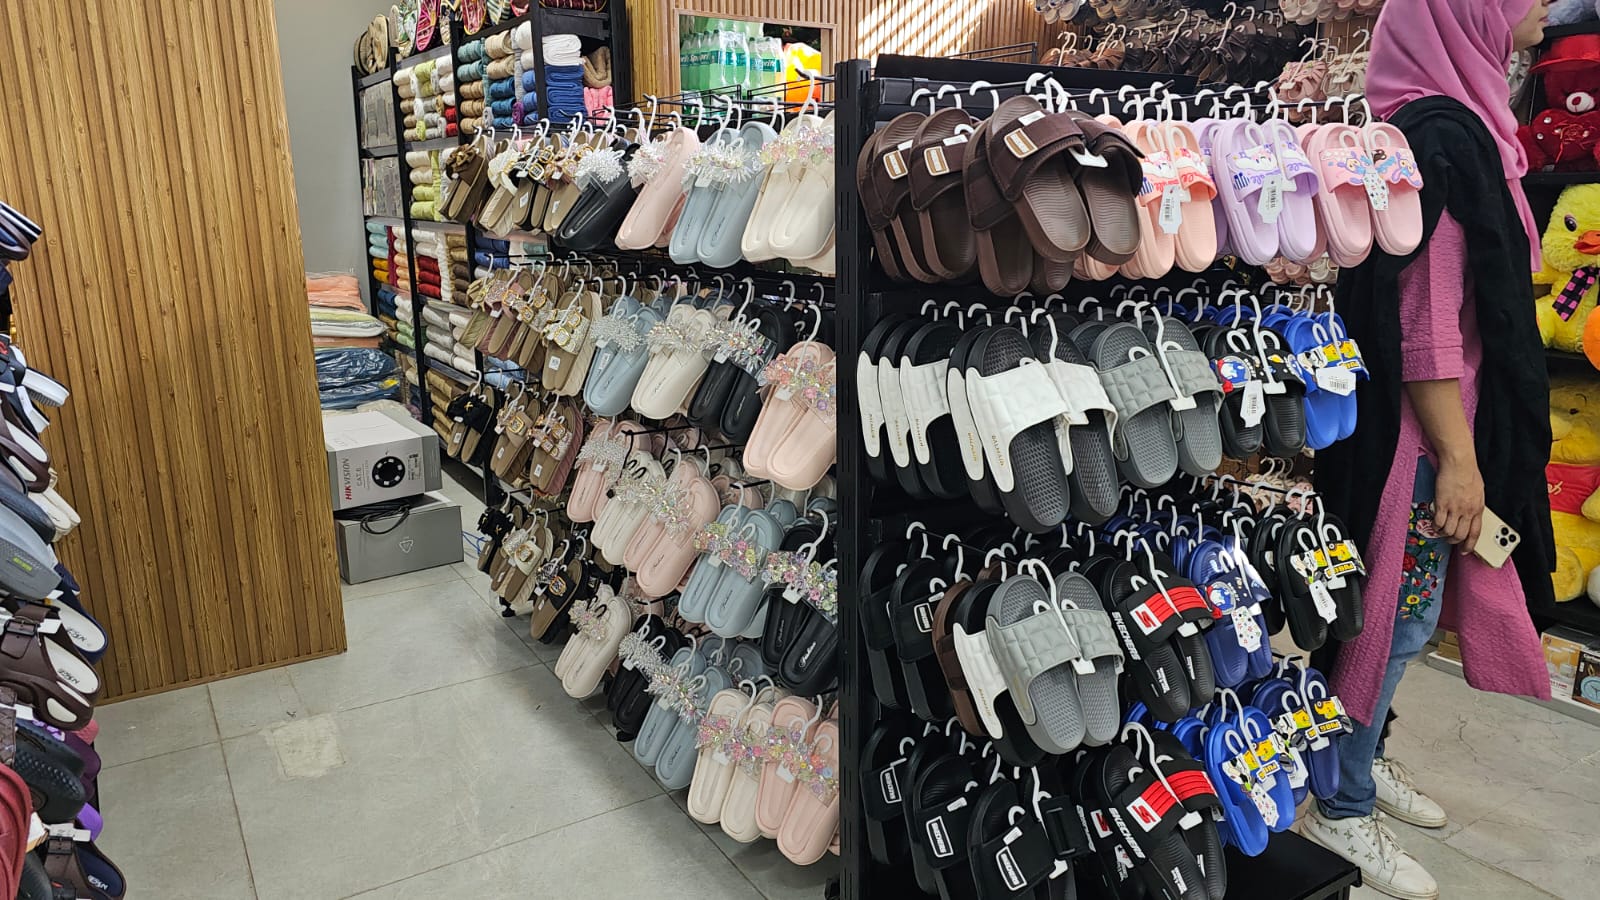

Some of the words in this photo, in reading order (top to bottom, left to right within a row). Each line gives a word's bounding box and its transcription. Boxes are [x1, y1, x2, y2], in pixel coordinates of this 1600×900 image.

[342, 457, 353, 501] HIKVISION
[1111, 611, 1141, 661] SKECHERS
[1108, 807, 1146, 859] SKECHERS
